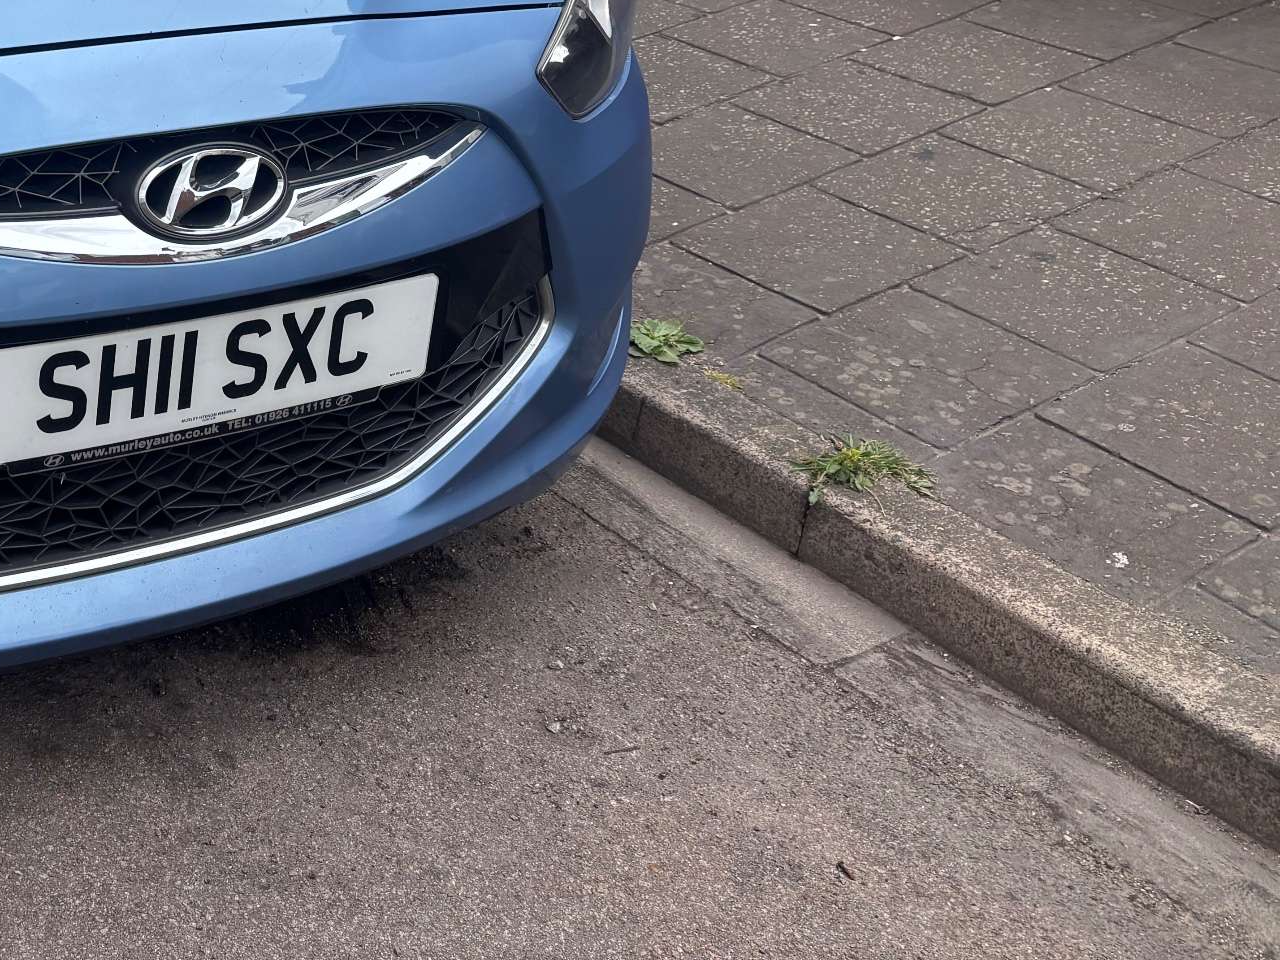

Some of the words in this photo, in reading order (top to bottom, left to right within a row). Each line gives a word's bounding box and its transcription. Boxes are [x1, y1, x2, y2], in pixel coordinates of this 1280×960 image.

[222, 298, 374, 399] SXC
[71, 423, 219, 462] www.murleyauto.co.uk
[227, 417, 252, 431] TEL:
[255, 409, 290, 424] 01926
[292, 399, 332, 416] 411115
